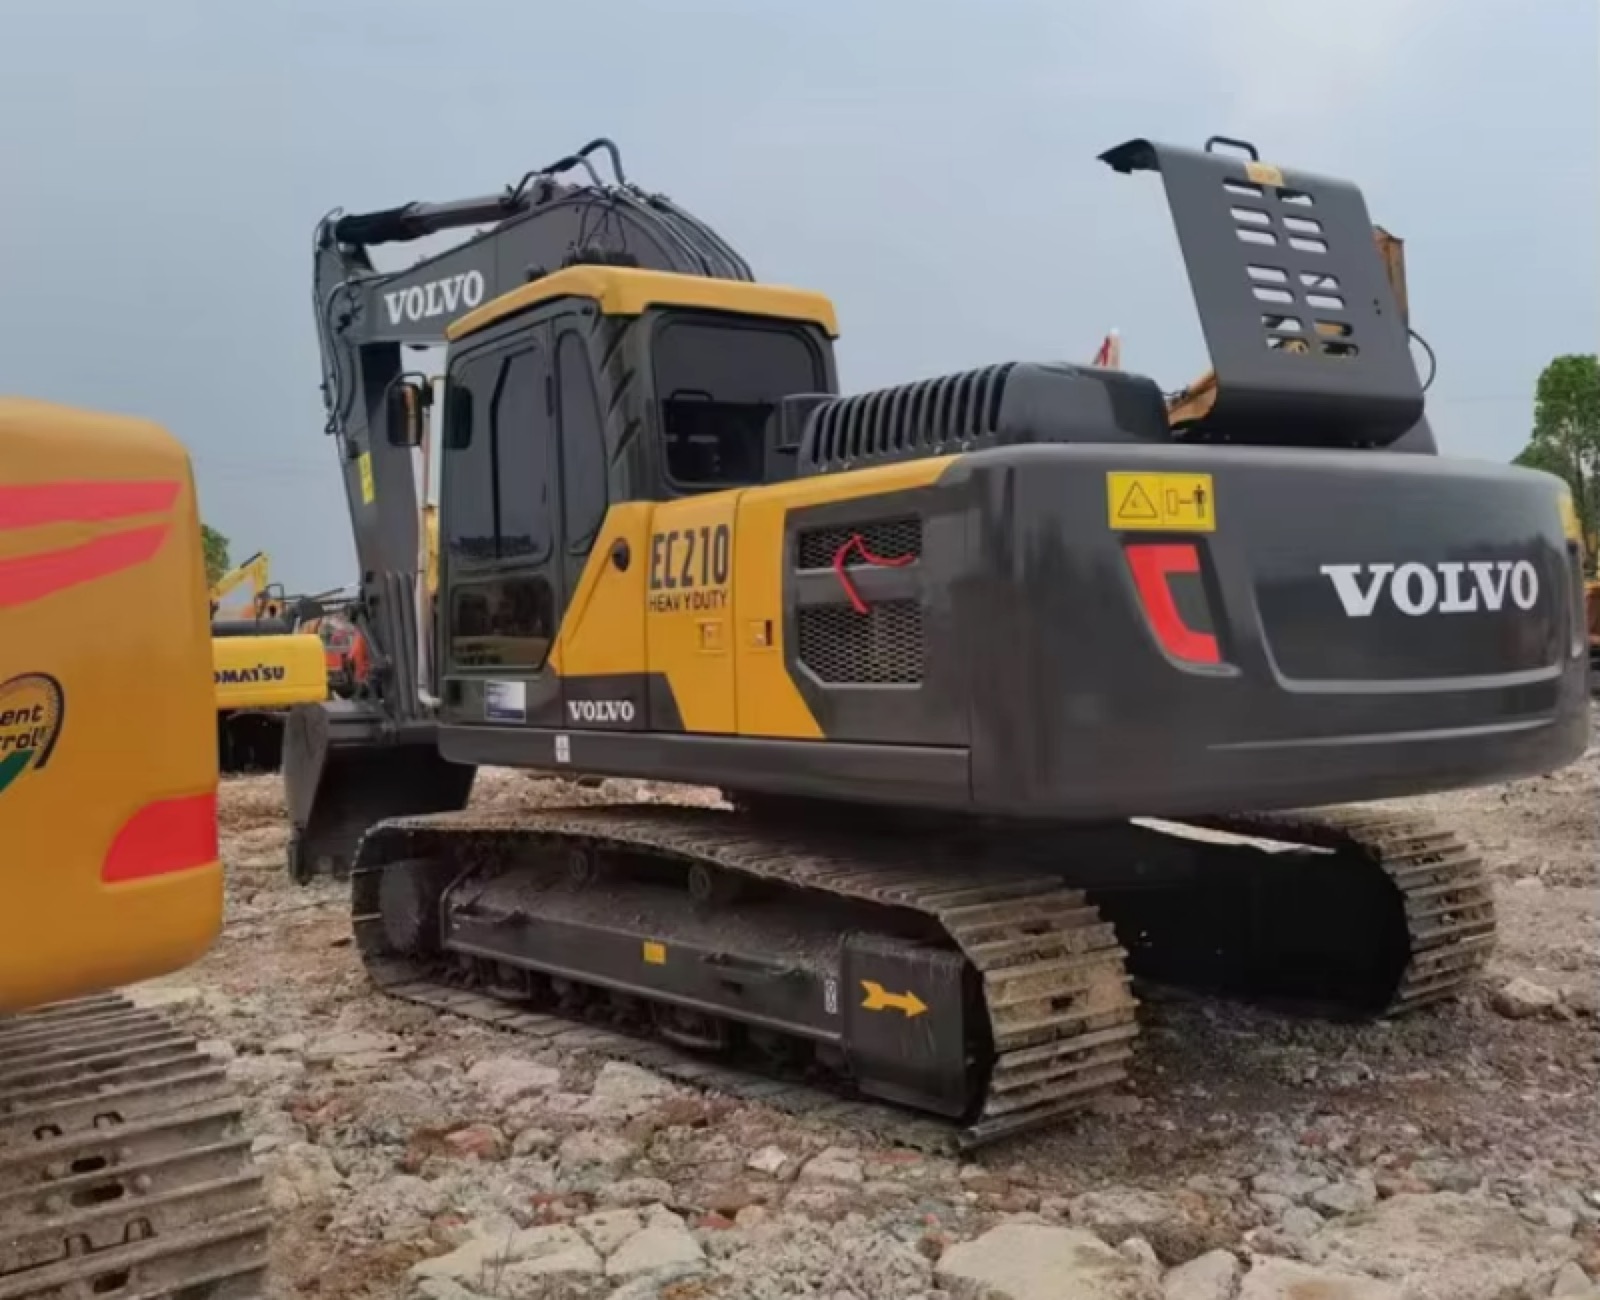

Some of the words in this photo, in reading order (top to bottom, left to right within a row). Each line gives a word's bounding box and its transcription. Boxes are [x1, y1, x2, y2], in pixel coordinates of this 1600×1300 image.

[384, 270, 484, 325] VOLVO
[650, 523, 729, 590] EC210
[1320, 559, 1539, 617] VOLVO
[567, 700, 635, 721] VOLVO
